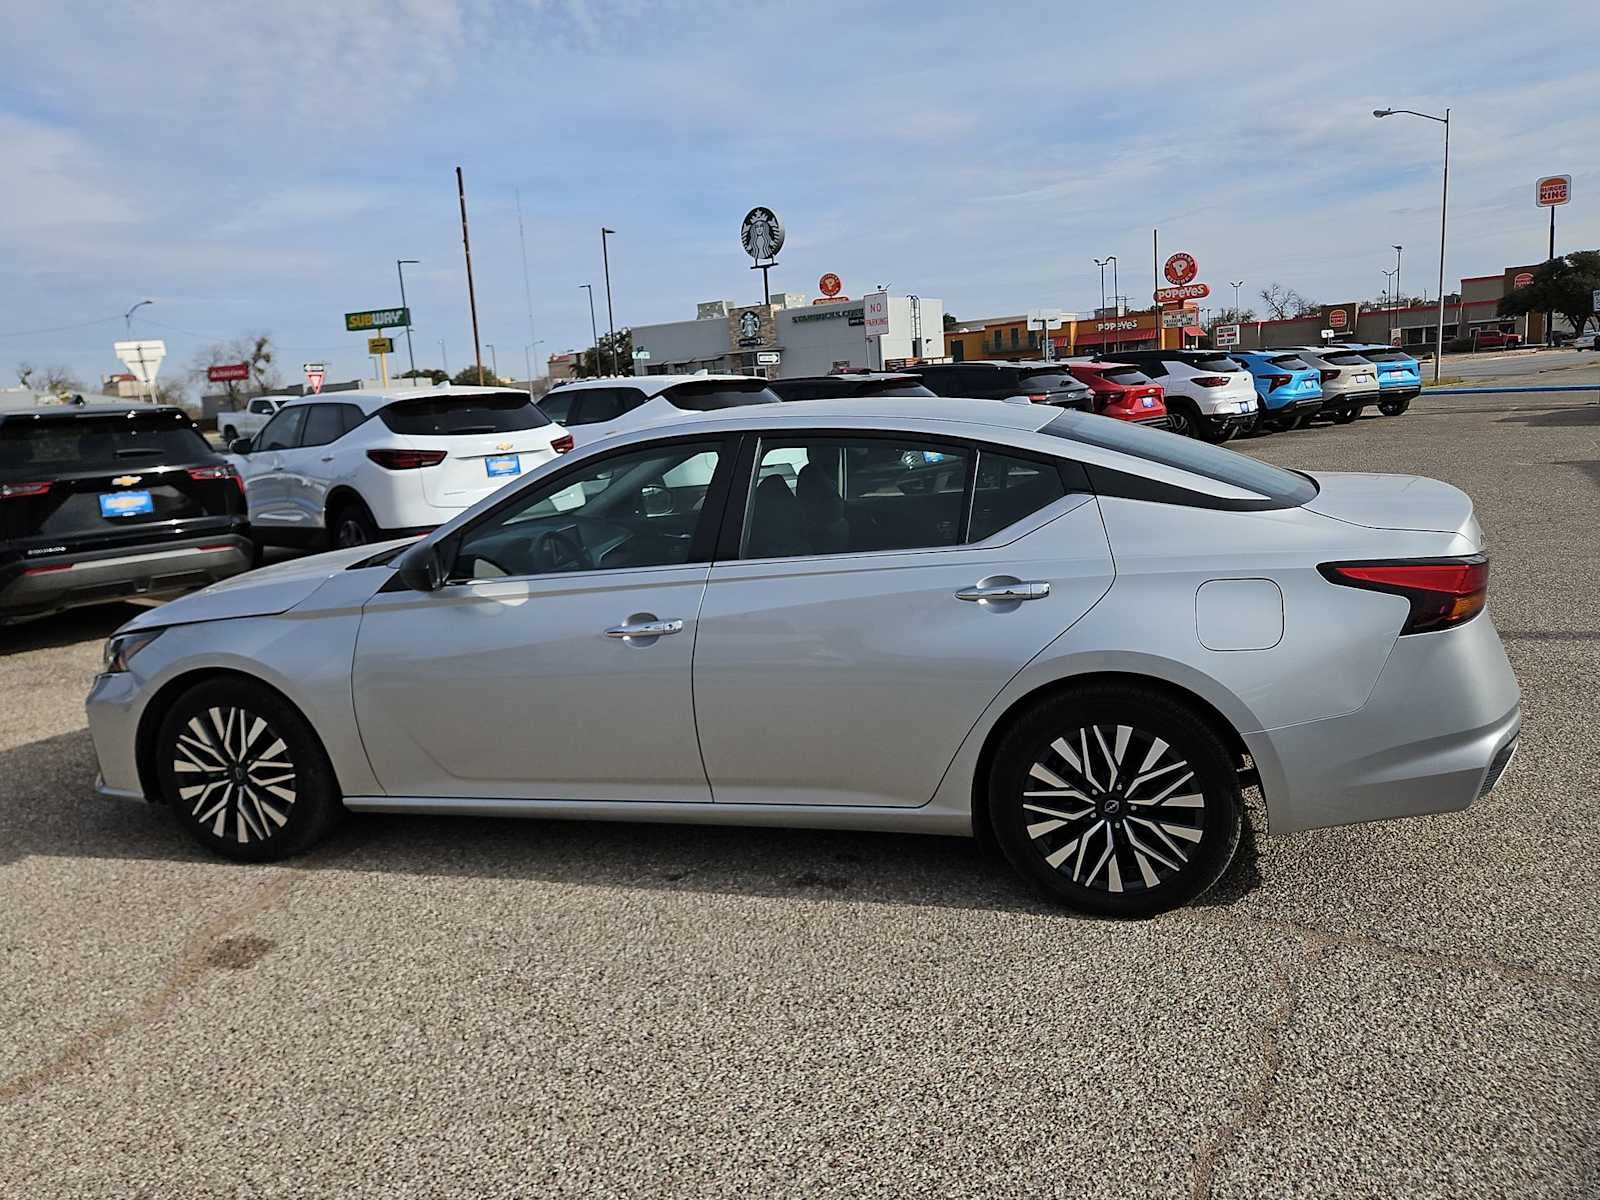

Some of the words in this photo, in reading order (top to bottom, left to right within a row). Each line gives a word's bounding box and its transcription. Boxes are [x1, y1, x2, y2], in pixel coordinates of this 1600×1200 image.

[1540, 184, 1567, 193] BURGER
[1540, 190, 1567, 200] KING
[1172, 260, 1188, 276] P
[870, 303, 881, 312] NO
[348, 310, 402, 328] SUBWAY
